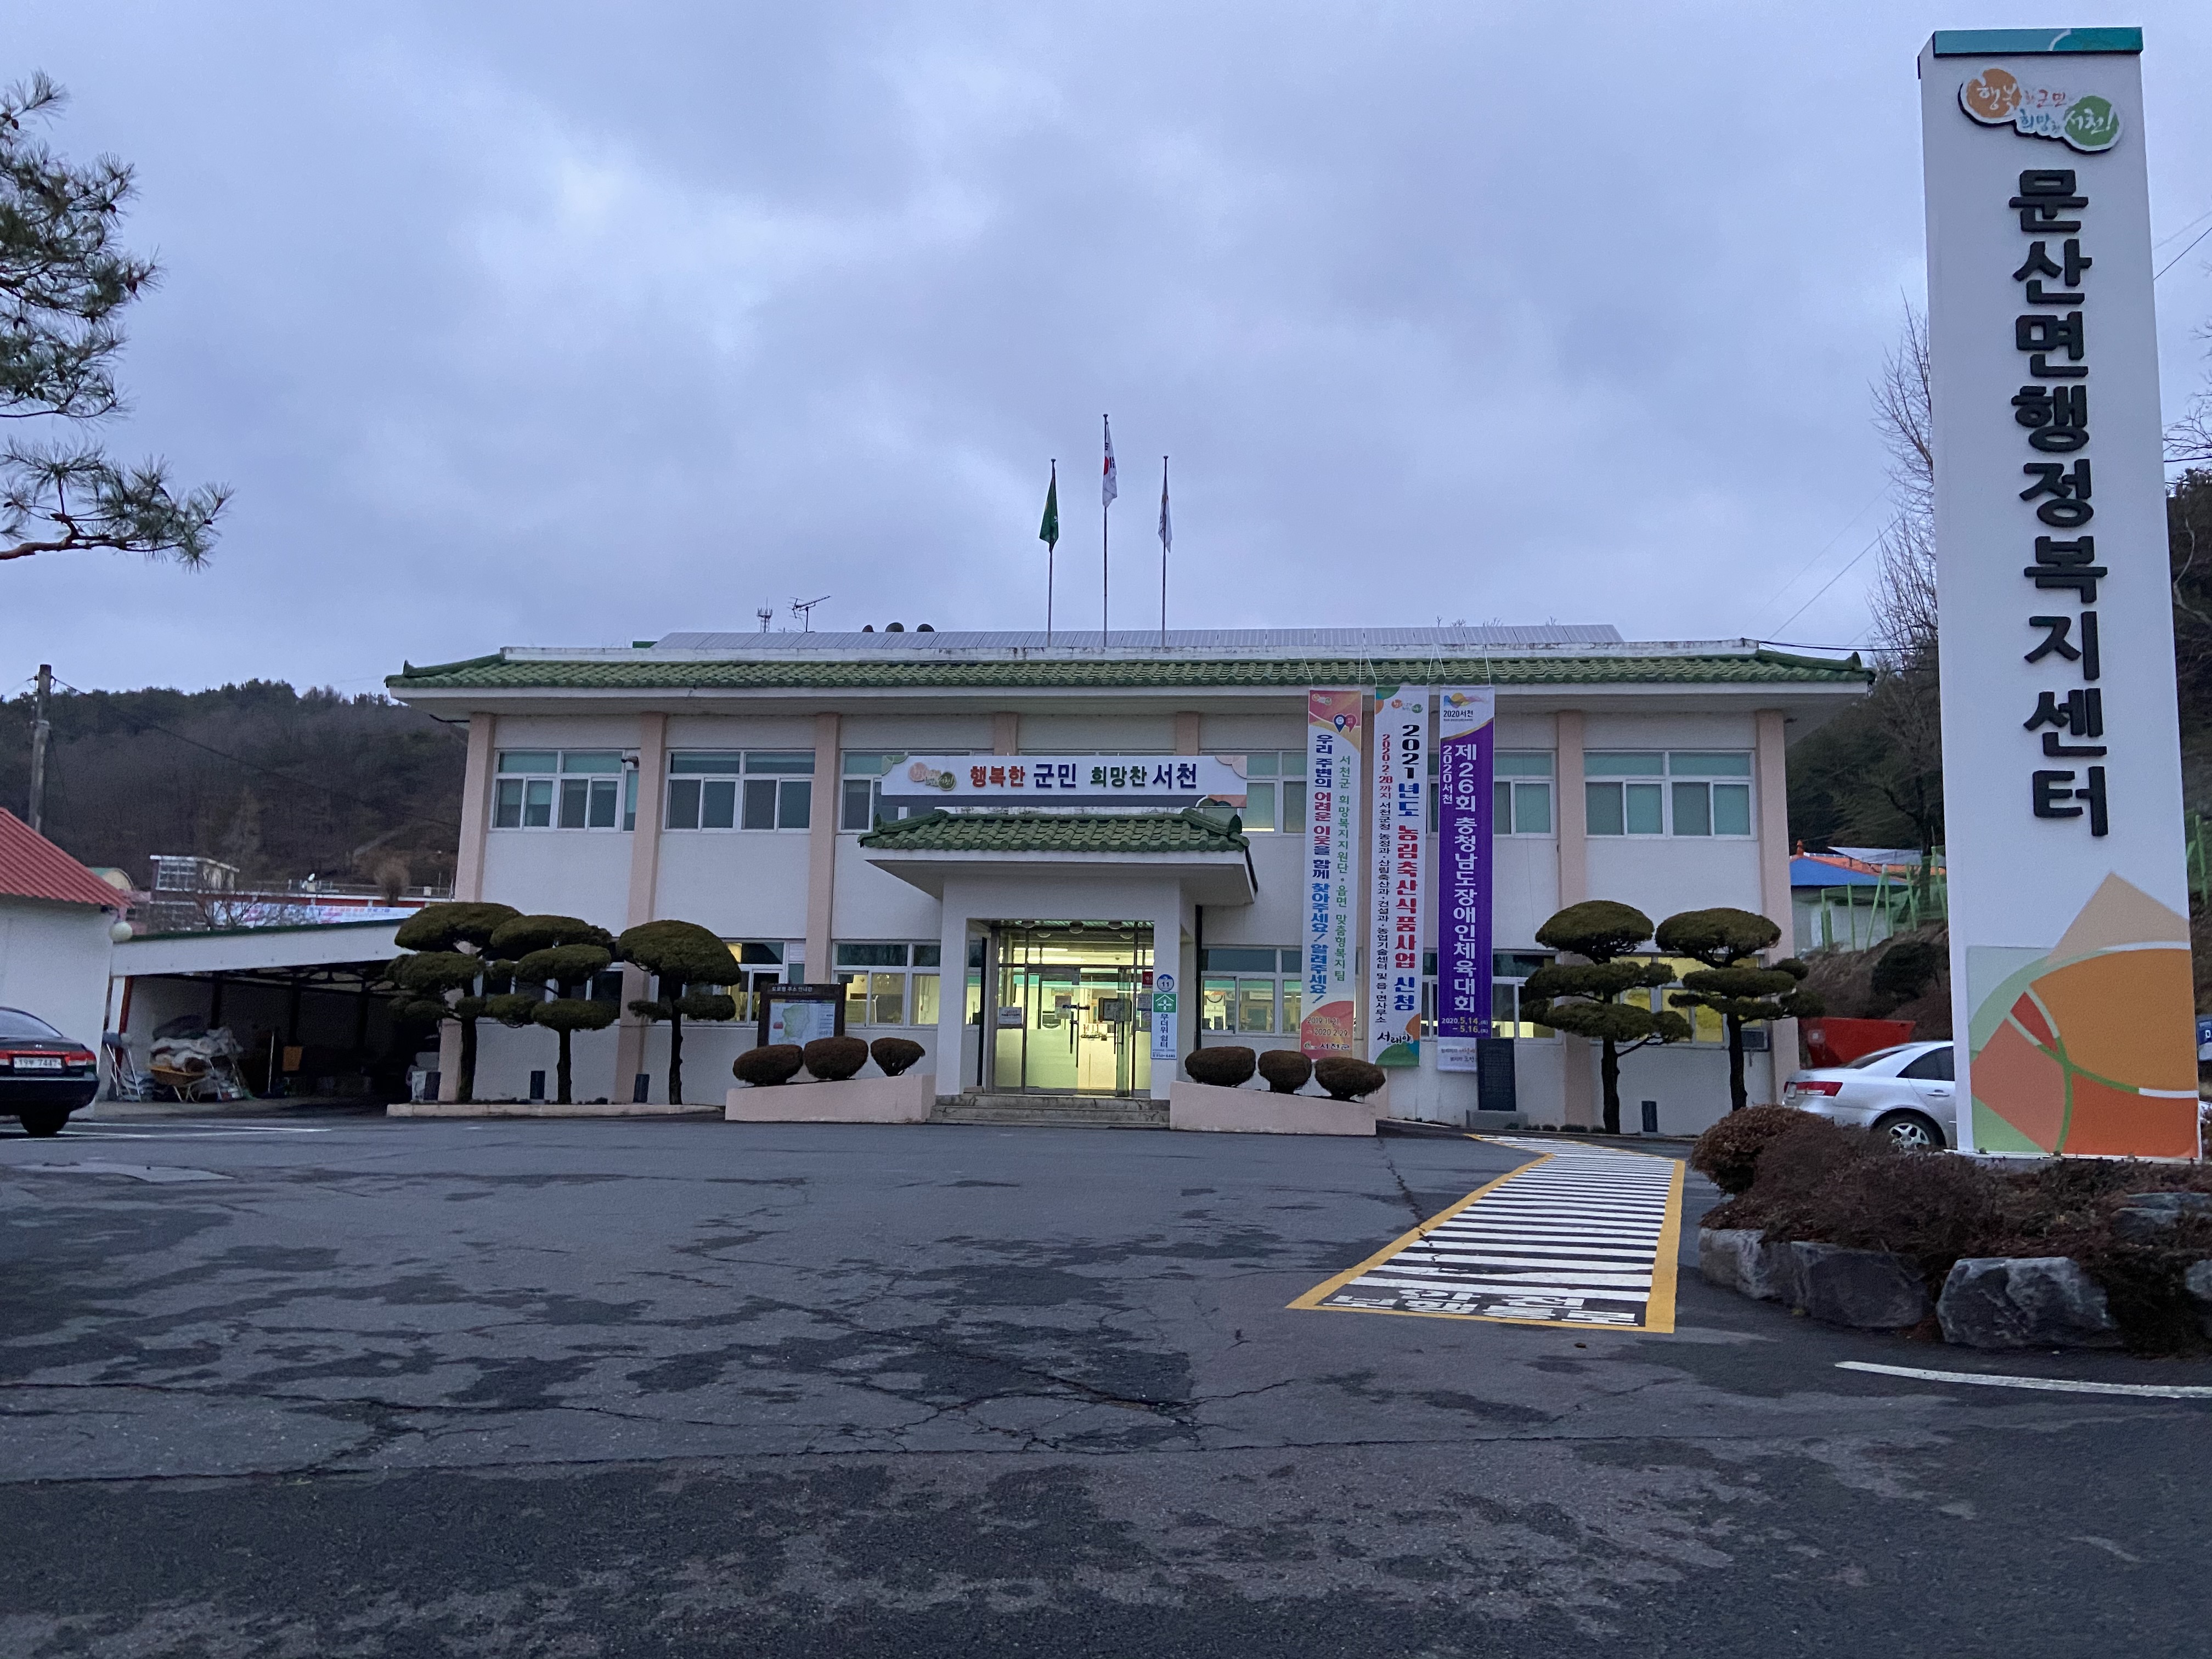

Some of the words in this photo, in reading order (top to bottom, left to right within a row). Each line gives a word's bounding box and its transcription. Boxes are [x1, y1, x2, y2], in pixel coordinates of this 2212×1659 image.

[1316, 734, 1333, 755] 우리
[970, 765, 1026, 788] 행복한
[1033, 763, 1076, 789] 군민
[1090, 765, 1147, 788] 희망찬
[1152, 763, 1197, 789] 서천
[1314, 758, 1333, 788] 주변의
[1339, 755, 1351, 789] 서천군
[1397, 724, 1420, 816] 2021년도
[1442, 744, 1453, 805] 2020서천
[1454, 743, 1477, 812] 제26회
[1314, 792, 1331, 822] 어려운
[1313, 825, 1331, 856] 이웃을
[1312, 859, 1331, 879] 함께
[1334, 914, 1347, 981] 맞춤형복지팀
[1393, 977, 1415, 1011] 신청
